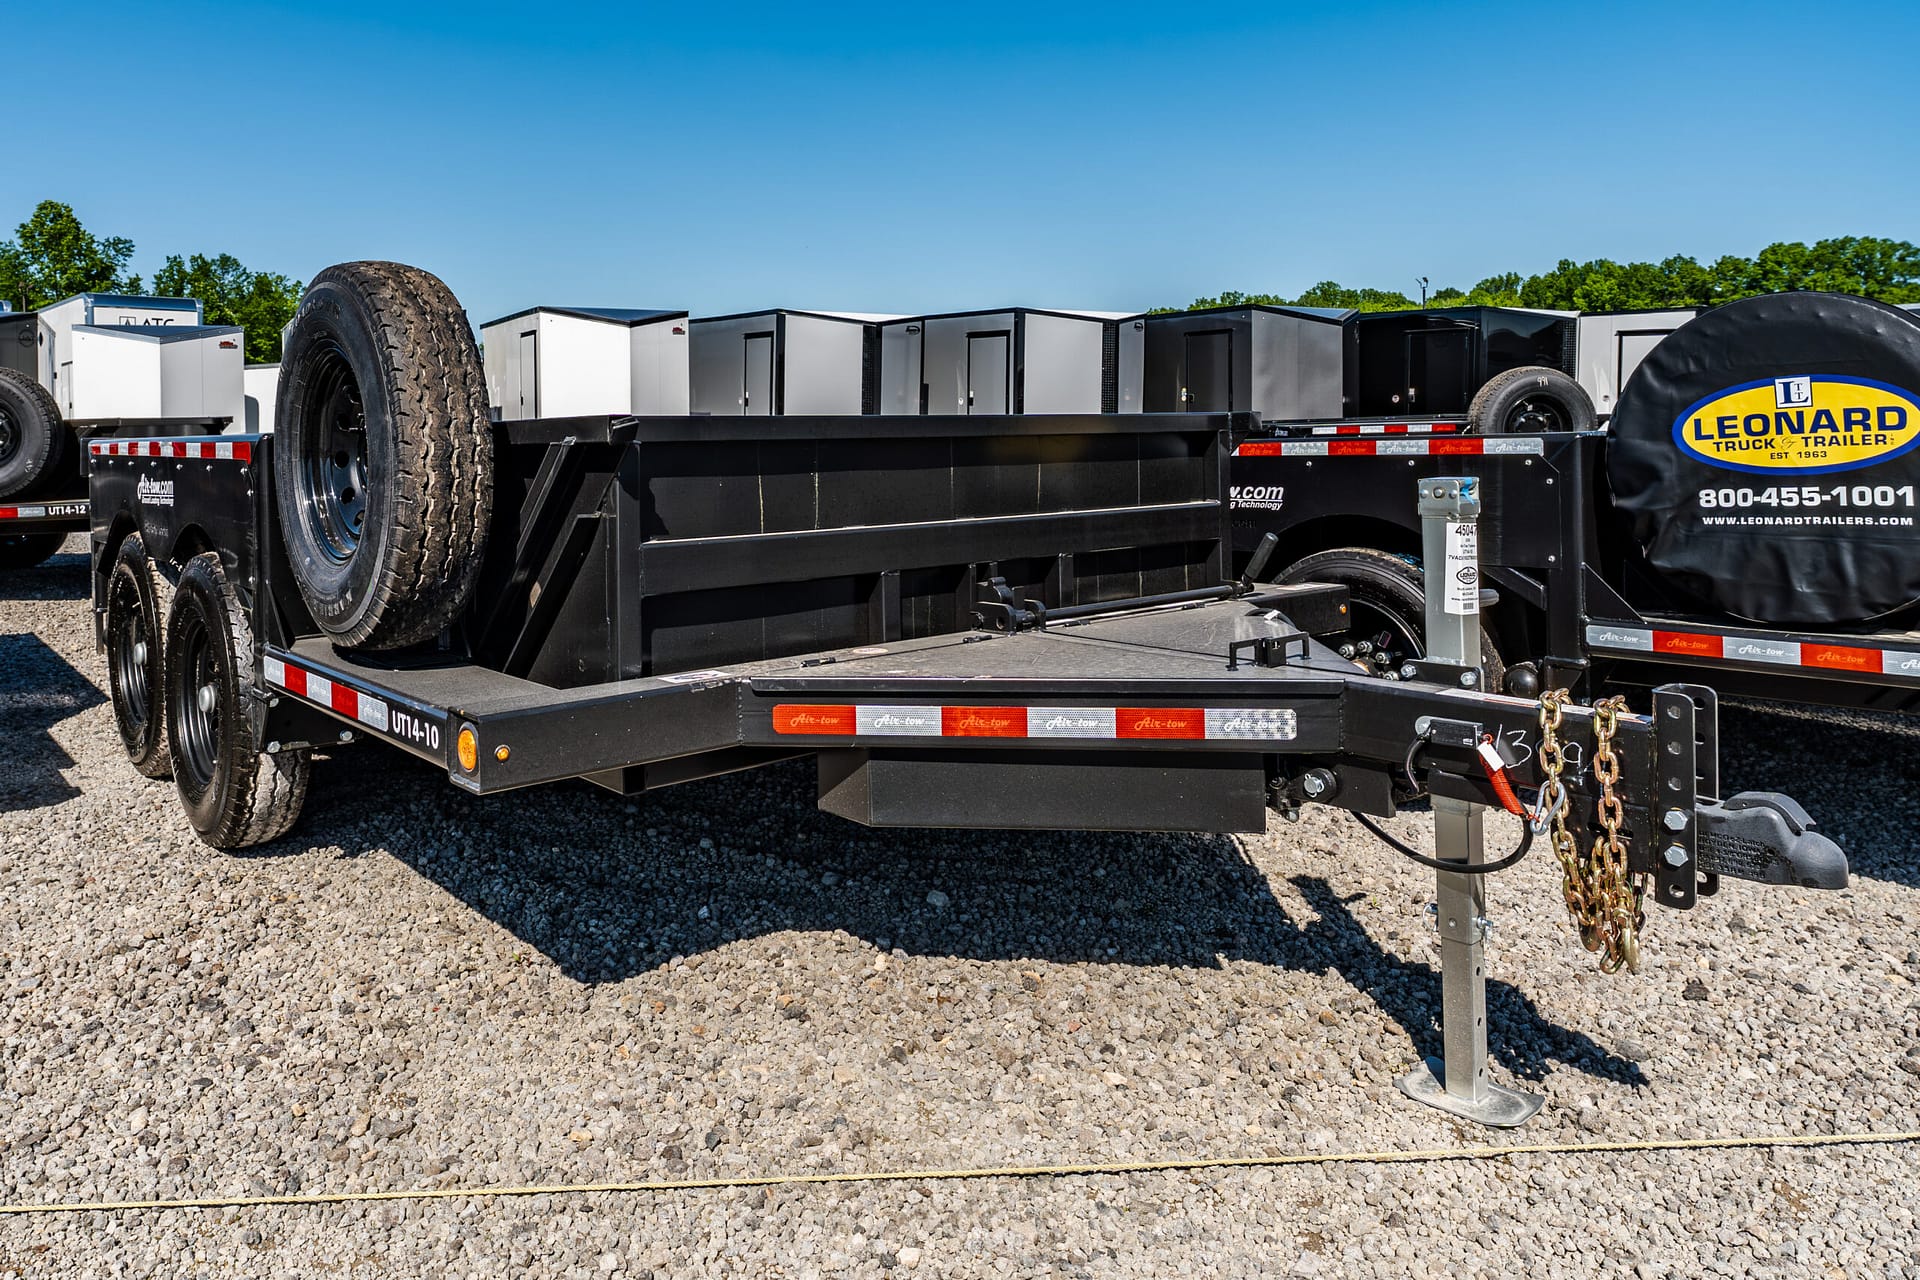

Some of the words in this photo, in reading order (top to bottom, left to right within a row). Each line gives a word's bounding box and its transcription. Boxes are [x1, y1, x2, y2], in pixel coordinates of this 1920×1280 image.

[1693, 406, 1907, 441] LEONARD
[1713, 438, 1775, 452] TRUCK
[1801, 434, 1888, 448] TRAILER
[1770, 452, 1790, 460] EST
[1797, 450, 1828, 459] 1963
[1699, 486, 1915, 508] 800-455-1001
[48, 505, 87, 516] UT14-12
[1238, 500, 1284, 511] Technology
[1702, 516, 1914, 526] WWW.LEONARDTRAILERS.COM
[1599, 631, 1639, 644] Air-tow
[1666, 638, 1709, 650] Air-tow
[1738, 644, 1785, 657] Air-tow
[1816, 650, 1866, 665] Air-tow
[790, 713, 840, 728] Air-tow
[874, 713, 926, 728] Air-tow
[959, 714, 1011, 730] Air-tow
[1046, 715, 1099, 730] Air-tow
[1134, 716, 1188, 731] Air-tow
[1223, 716, 1282, 731] Air-tow
[391, 710, 440, 750] UT14-10
